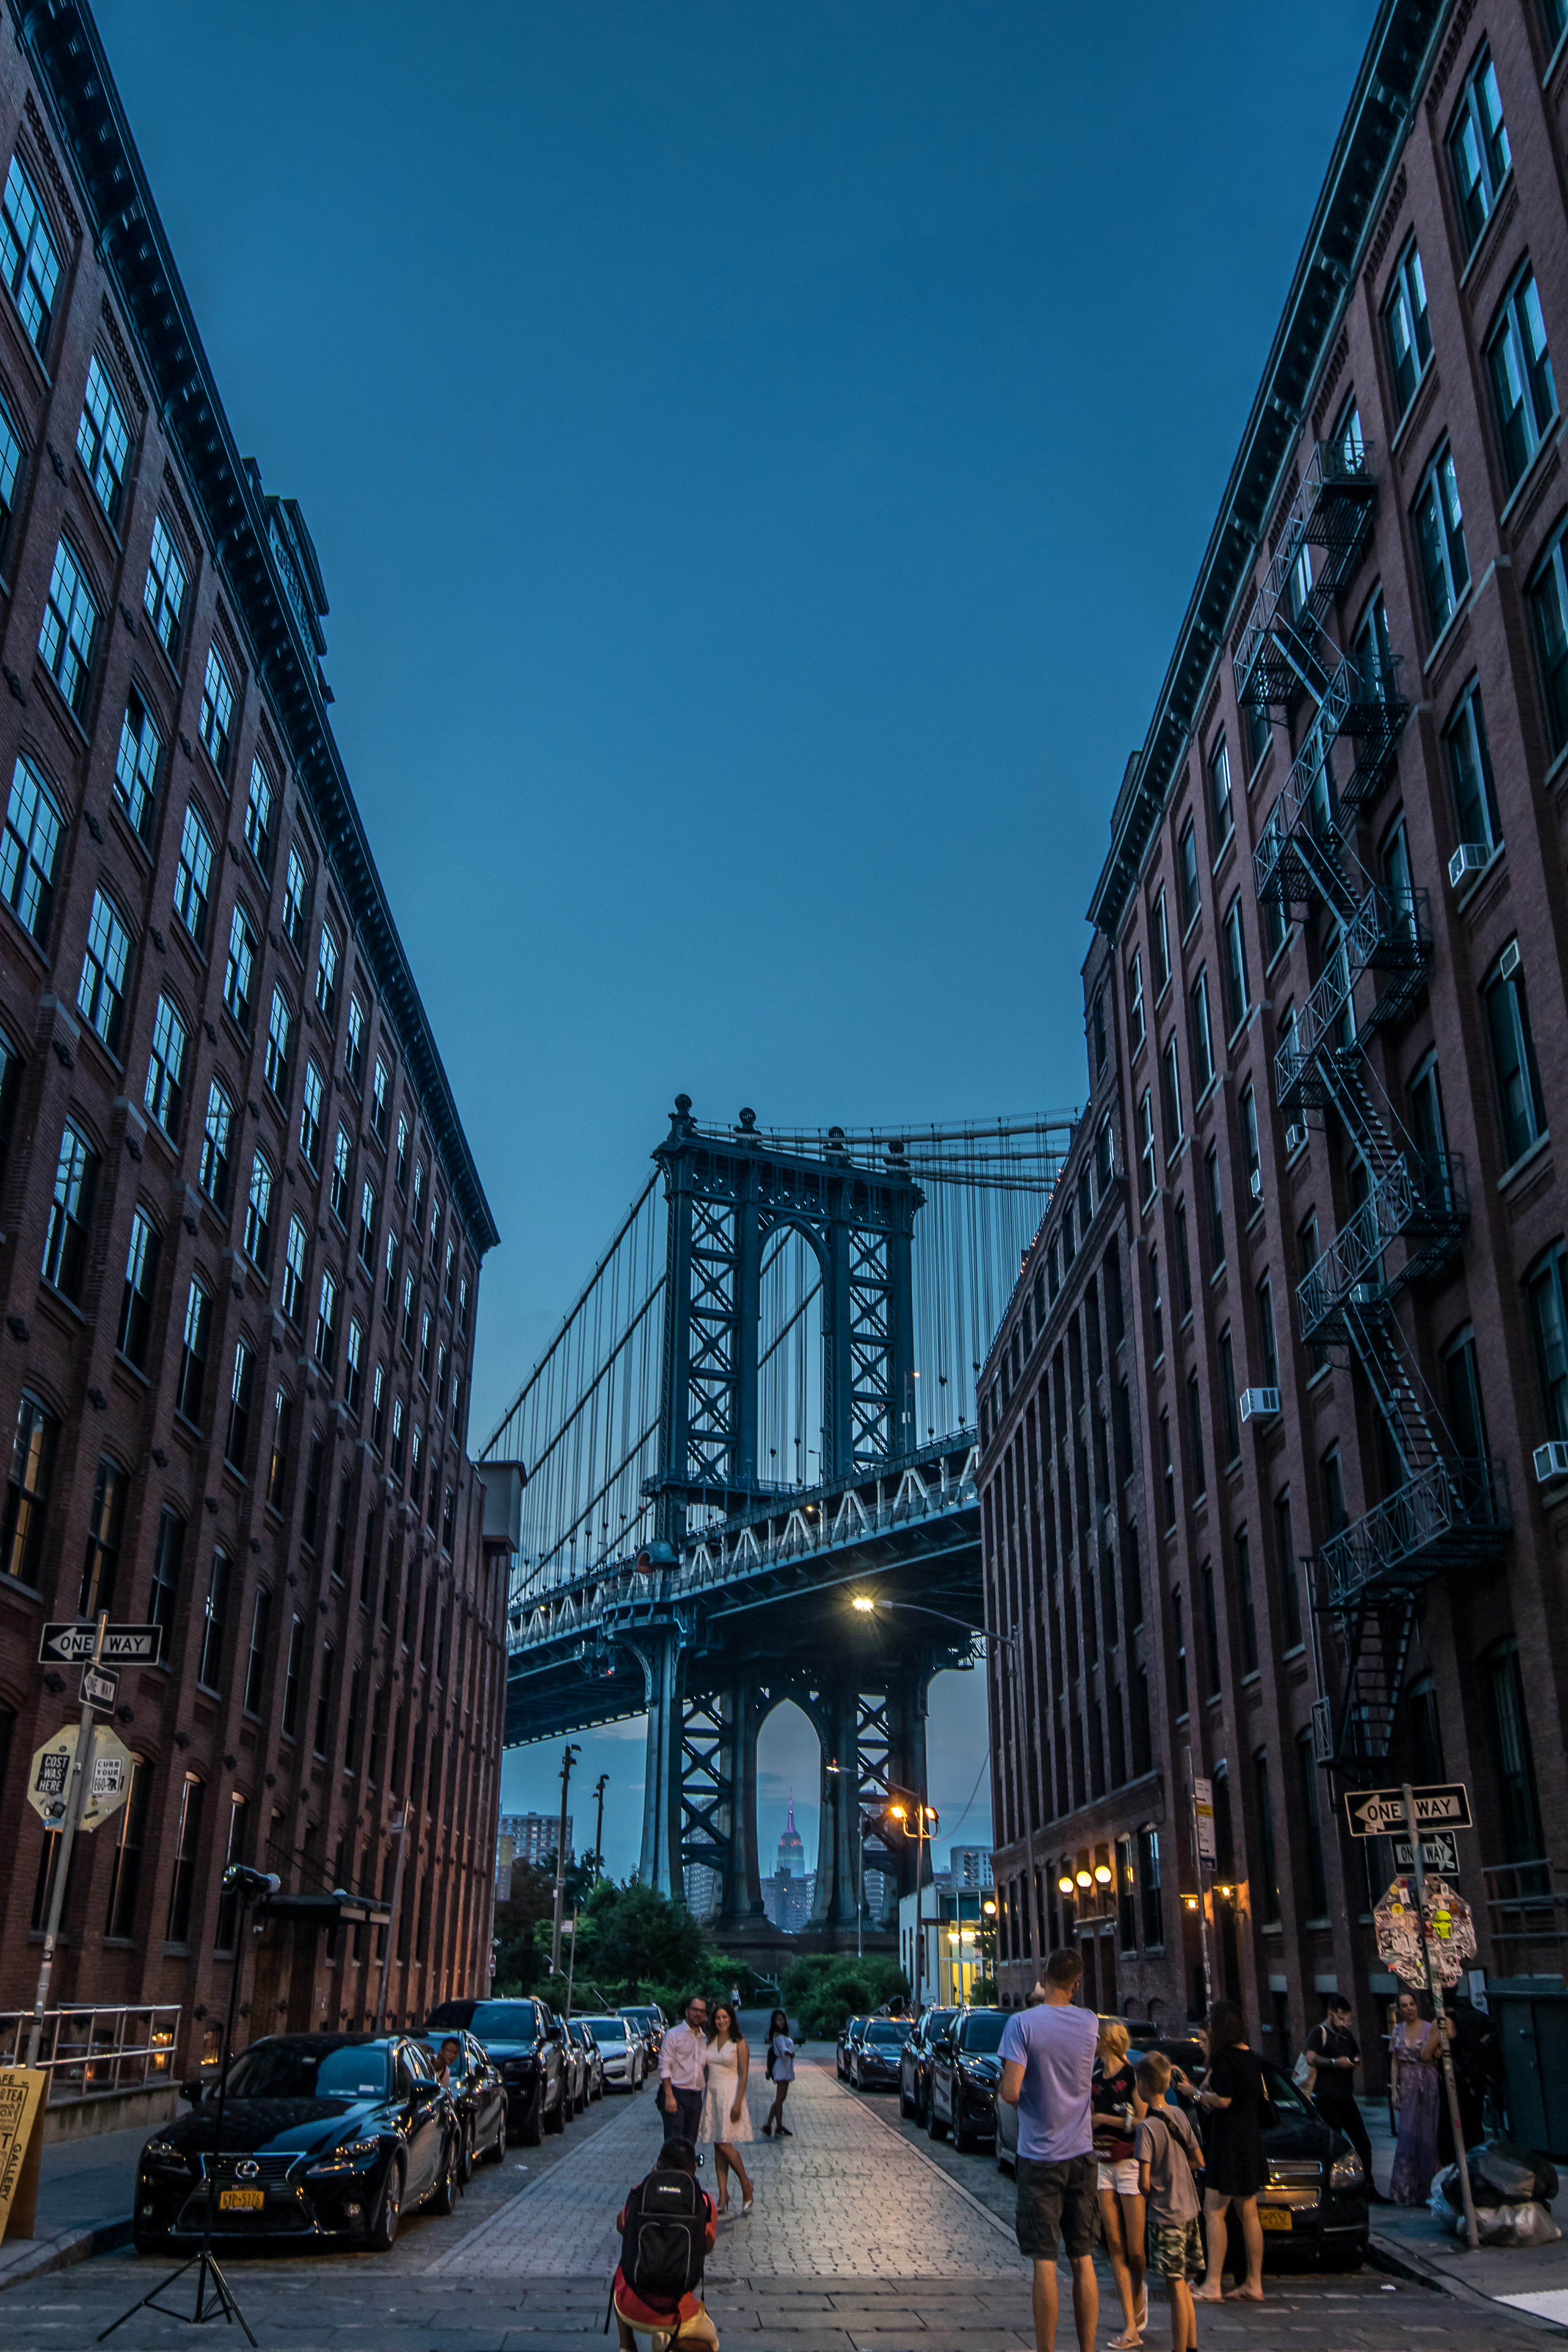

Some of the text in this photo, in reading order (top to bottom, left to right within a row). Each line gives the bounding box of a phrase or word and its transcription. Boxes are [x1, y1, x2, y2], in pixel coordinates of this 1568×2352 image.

[60, 1636, 145, 1652] ONE WAY
[86, 1675, 98, 1693] ONE
[45, 1756, 68, 1768] COST
[44, 1768, 62, 1780] WAS
[39, 1780, 62, 1792] HERE
[1367, 1799, 1450, 1820] ONE WAY
[1401, 1845, 1445, 1862] ON WAY
[0, 2143, 22, 2201] GALLERY
